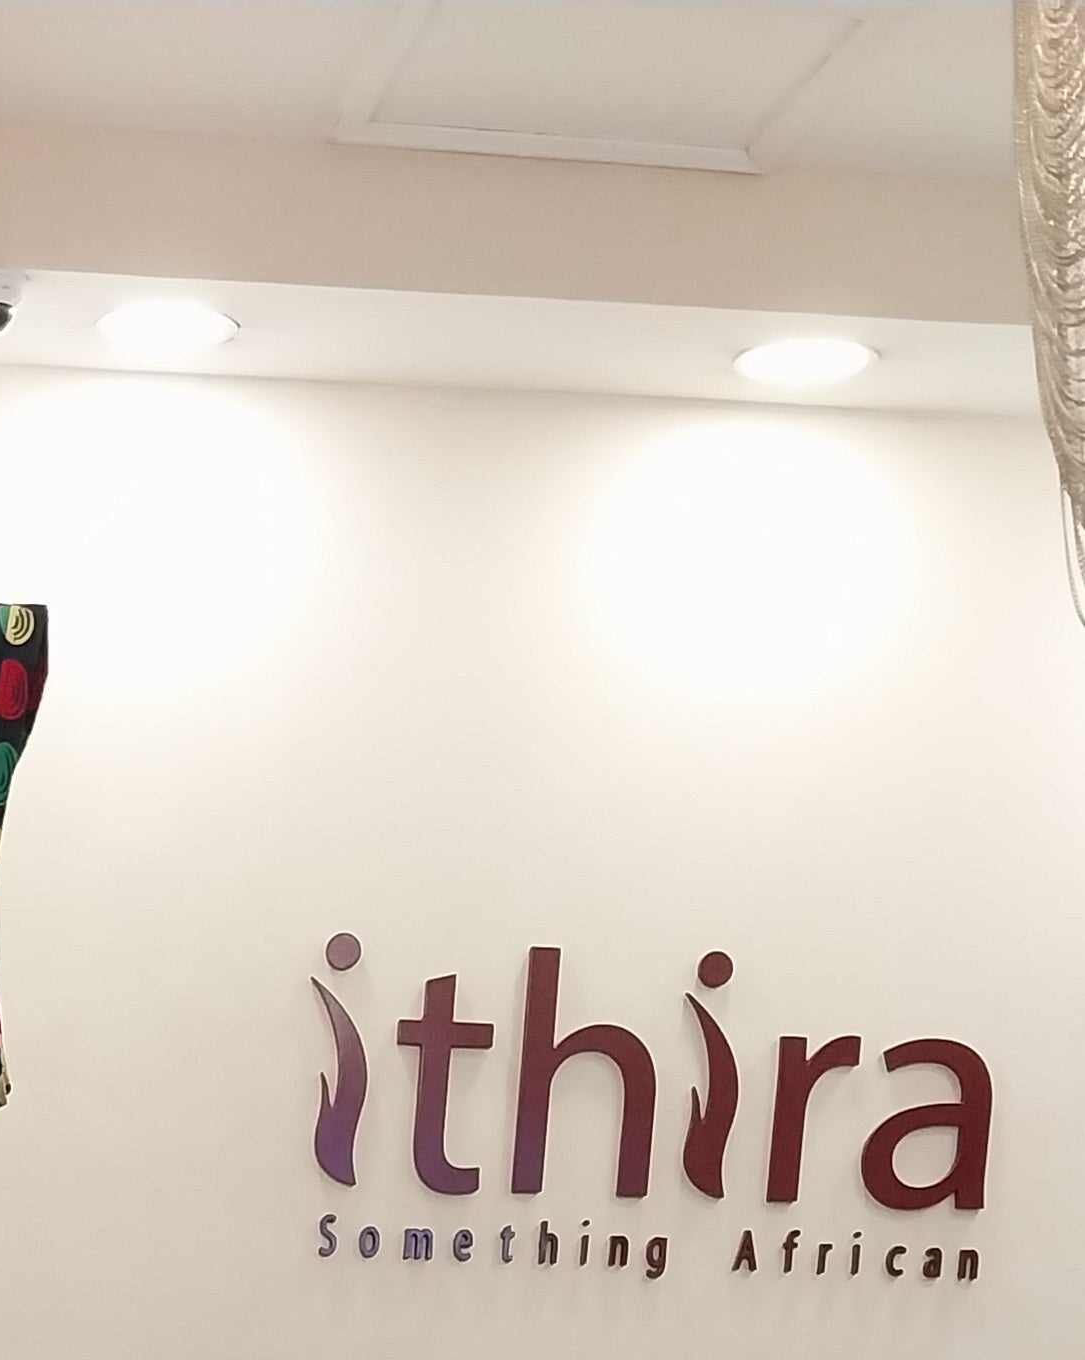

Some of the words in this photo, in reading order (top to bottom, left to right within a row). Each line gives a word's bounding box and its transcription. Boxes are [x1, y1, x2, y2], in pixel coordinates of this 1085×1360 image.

[310, 931, 994, 1213] ithira
[317, 1212, 669, 1281] Something
[731, 1229, 981, 1282] African
